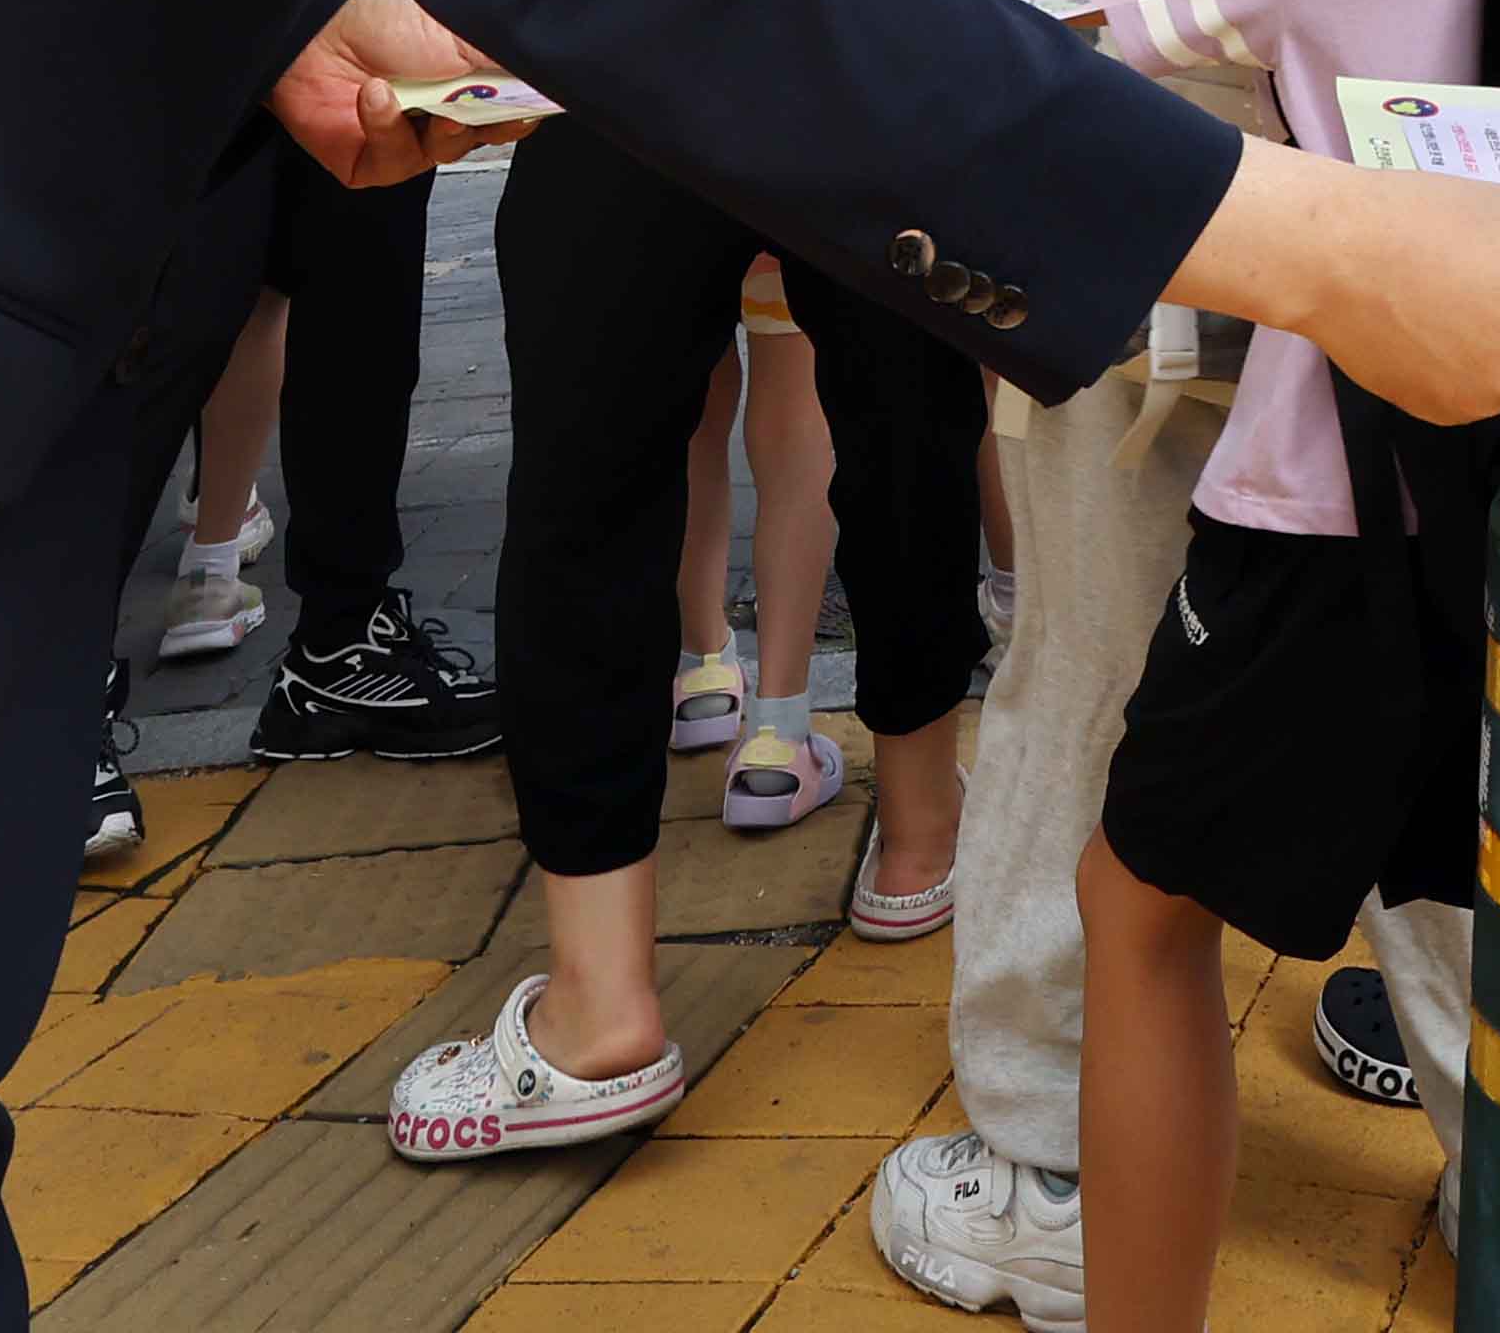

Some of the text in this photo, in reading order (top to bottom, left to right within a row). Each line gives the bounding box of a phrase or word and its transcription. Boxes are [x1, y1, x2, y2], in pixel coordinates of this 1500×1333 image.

[395, 1111, 502, 1150] crocs
[953, 1177, 981, 1202] FILA
[901, 1244, 957, 1289] FILA
